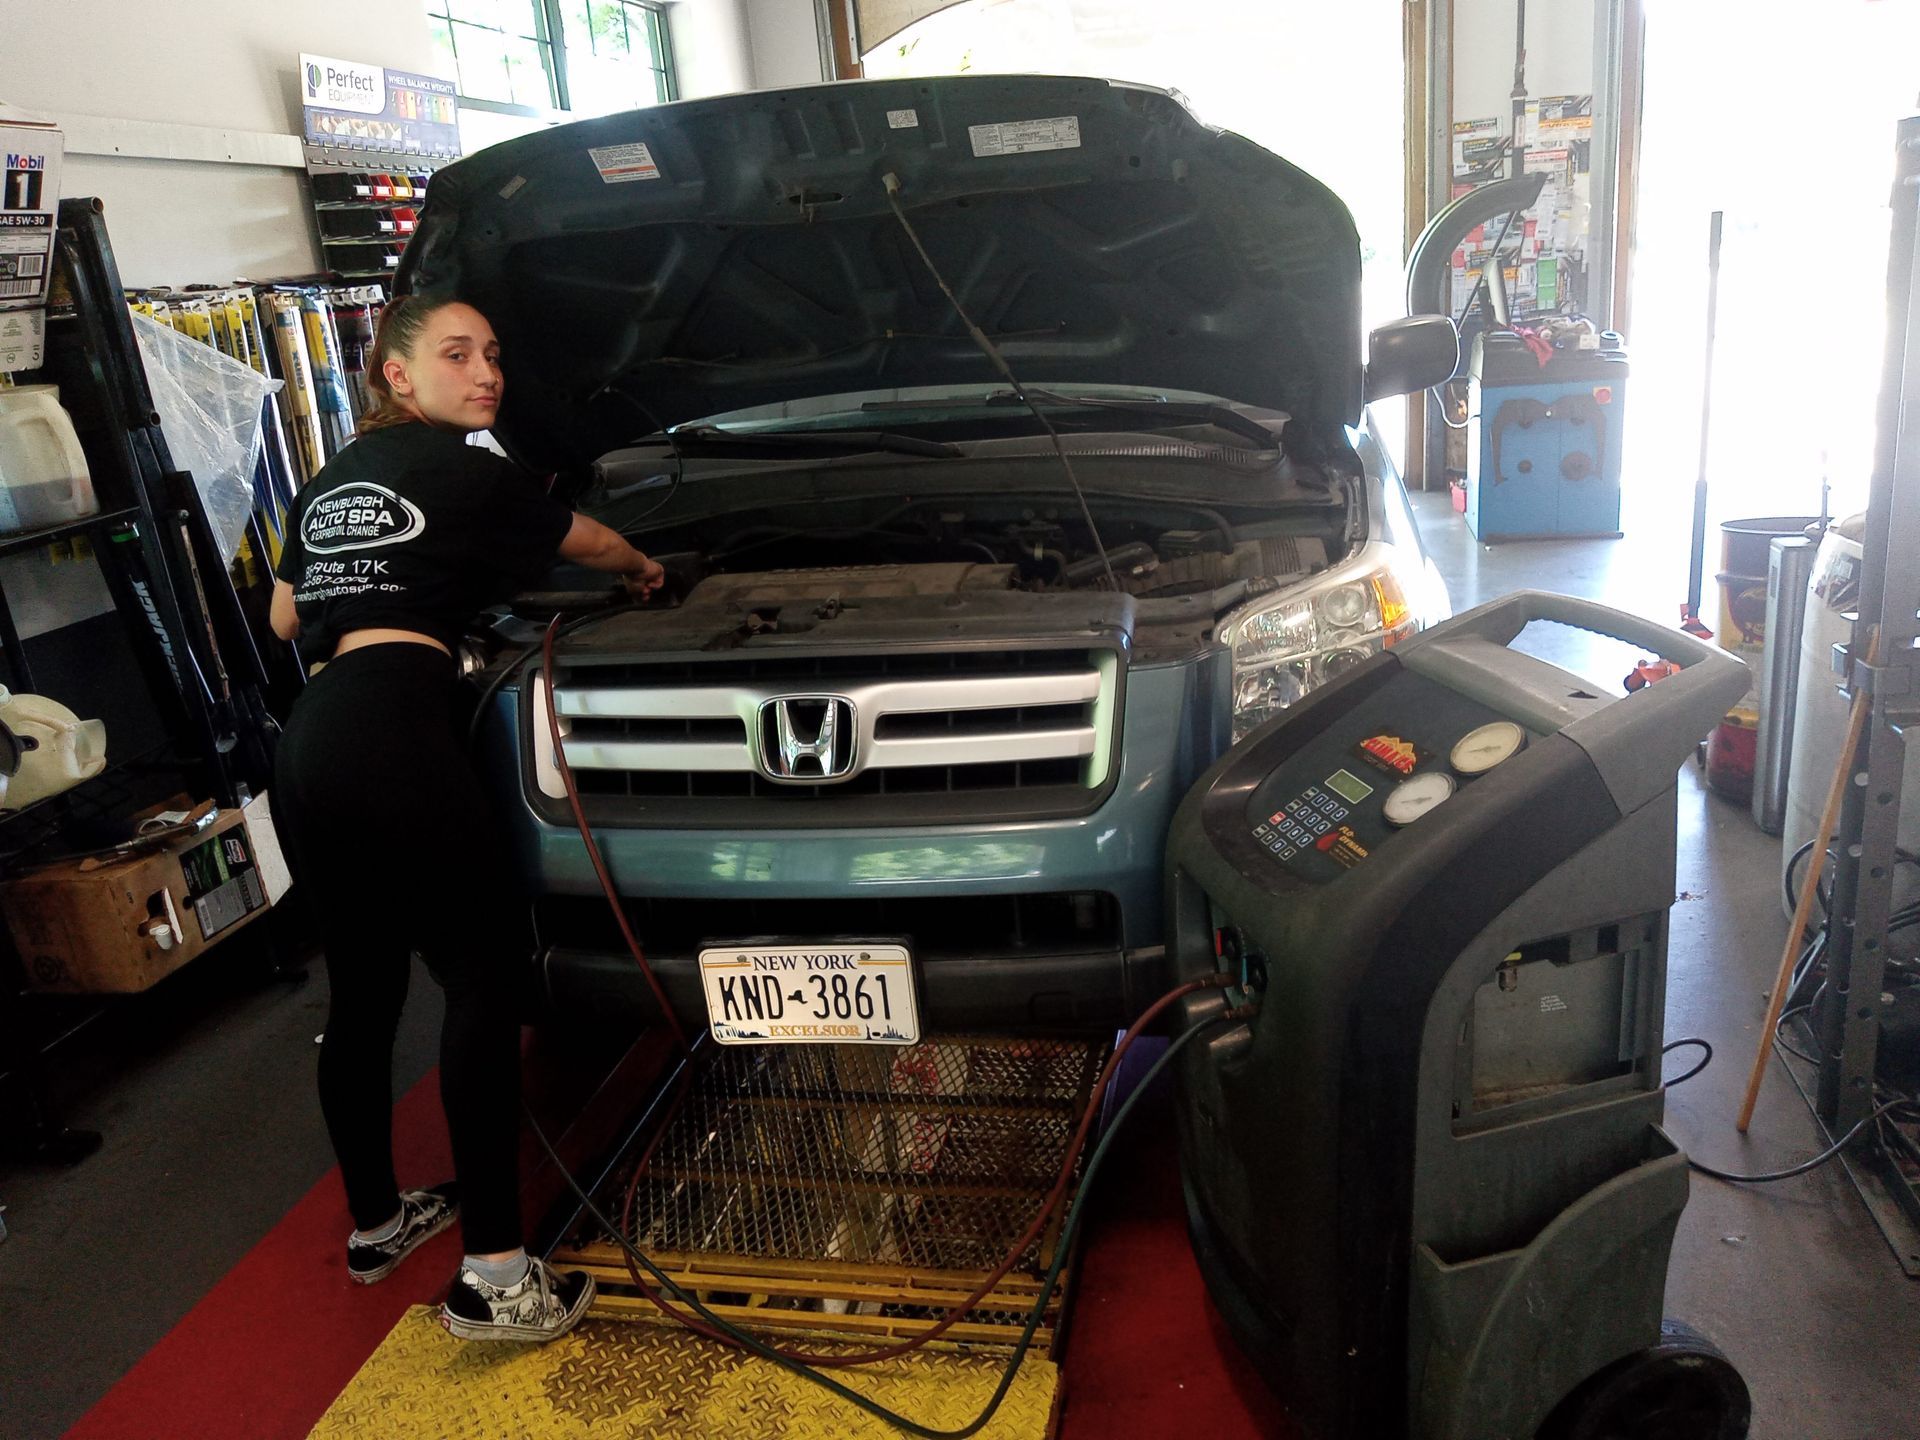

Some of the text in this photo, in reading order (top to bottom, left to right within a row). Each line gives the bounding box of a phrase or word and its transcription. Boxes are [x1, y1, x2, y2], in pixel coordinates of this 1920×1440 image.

[327, 67, 374, 92] Perfect
[388, 75, 454, 94] WHEEL BALANCE WEIGHTS
[328, 88, 375, 105] EQUIPMENT
[7, 154, 44, 169] Mobil
[16, 173, 29, 208] 1
[15, 216, 45, 226] 5W-30
[316, 496, 384, 515] NEWBURGH
[308, 509, 395, 532] AUTO SPA
[315, 528, 336, 541] EXPRESS
[336, 527, 345, 537] OIL
[346, 525, 380, 537] CHANGE
[352, 560, 390, 574] 17K
[752, 954, 857, 971] NEW YORK
[718, 974, 891, 1021] KND 3861
[766, 1024, 861, 1037] EXCELSIOR
